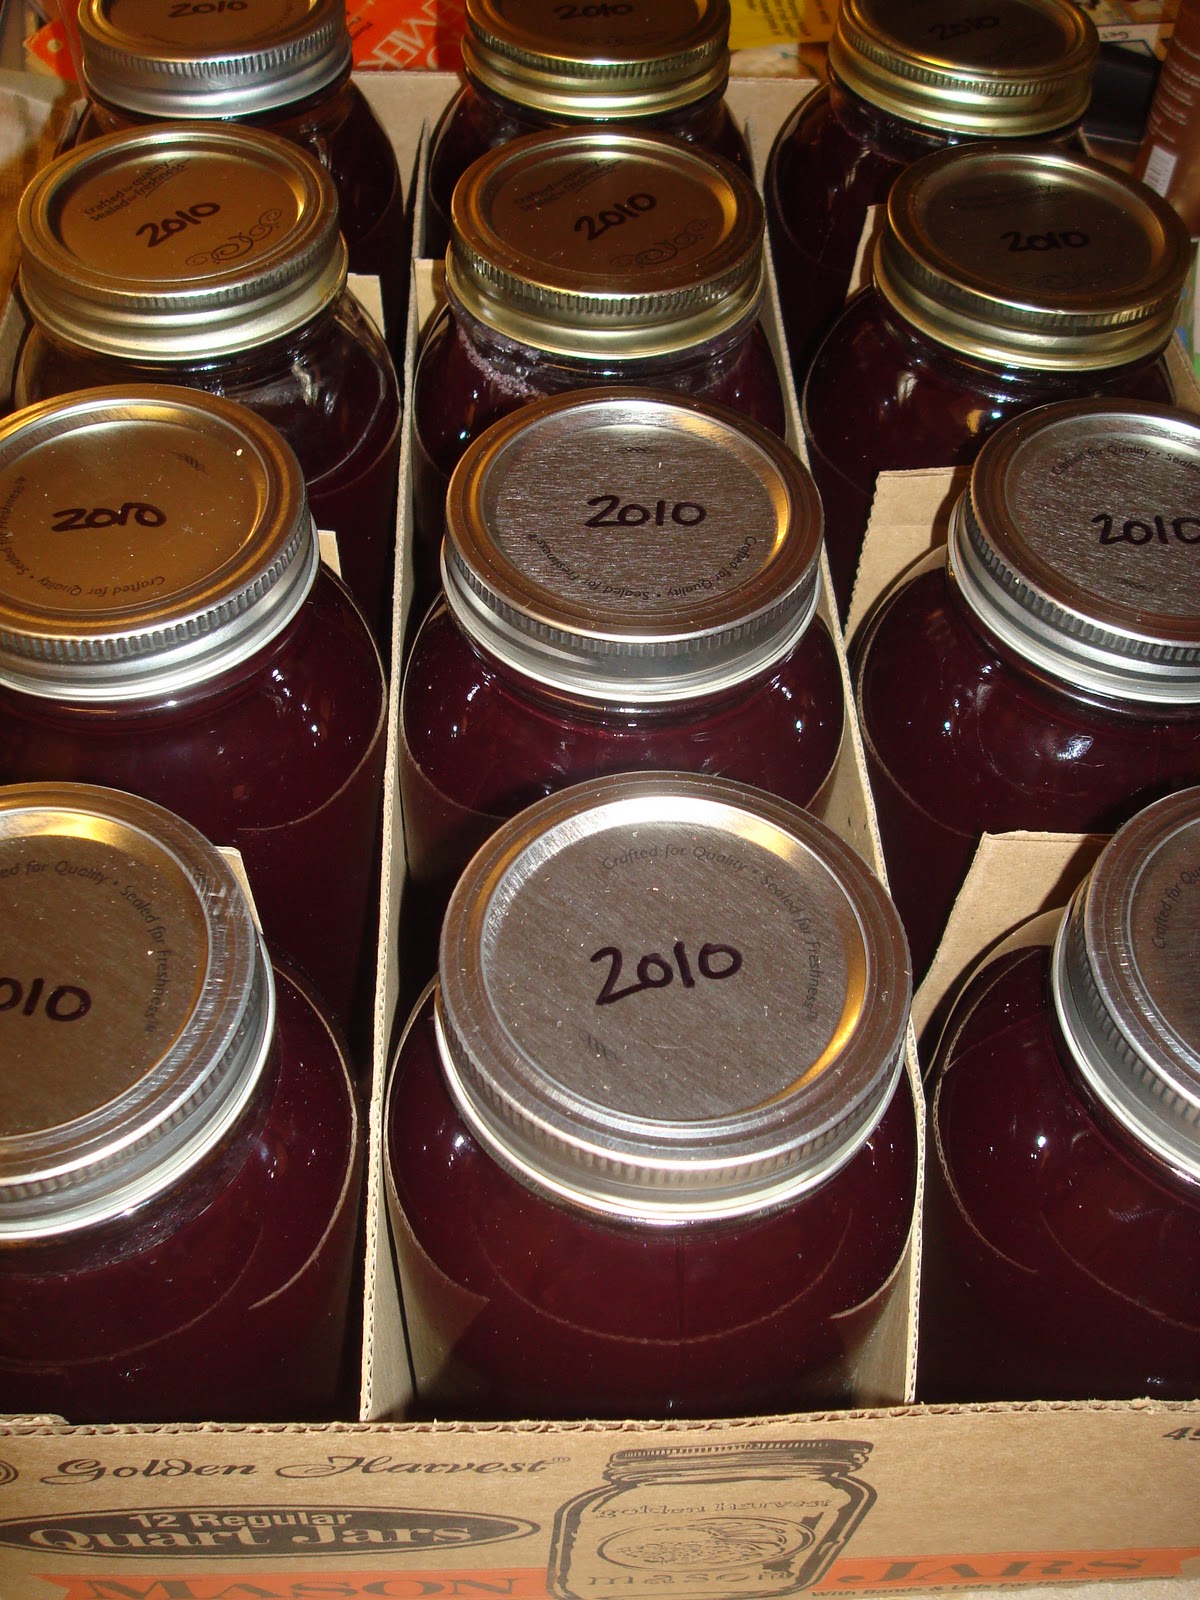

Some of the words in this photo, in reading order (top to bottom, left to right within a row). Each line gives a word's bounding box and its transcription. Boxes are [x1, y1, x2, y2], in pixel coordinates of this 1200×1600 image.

[167, 0, 249, 18] 2010
[554, 3, 634, 20] 2010
[133, 161, 169, 186] quality
[135, 202, 221, 248] 2010
[574, 192, 657, 241] 2010
[1000, 231, 1091, 252] 2010
[1087, 446, 1104, 459] for
[1107, 444, 1151, 459] Quality
[1166, 452, 1200, 475] Seale
[51, 502, 167, 532] 2010
[584, 494, 707, 528] 2010
[1091, 513, 1200, 545] 2010
[729, 535, 757, 570] Crafted
[37, 576, 82, 596] Quality
[112, 576, 166, 596] Crafted
[581, 578, 601, 591] for
[713, 566, 732, 582] for
[87, 586, 108, 597] for
[602, 583, 651, 601] Sealed
[667, 579, 713, 598] Quality
[602, 844, 658, 871] Crafted
[663, 843, 687, 857] for
[693, 845, 748, 873] Quality
[760, 872, 800, 915] Sealed
[793, 917, 811, 935] for
[25, 860, 48, 875] for
[54, 860, 109, 886] Quality
[119, 885, 161, 923] Sealed
[147, 925, 167, 944] for
[1151, 899, 1173, 949] Crafted
[1164, 882, 1183, 904] for
[590, 940, 743, 1006] 2010
[39, 1458, 258, 1485] Golden
[129, 1513, 181, 1528] 12
[189, 1511, 352, 1529] Regular
[595, 1503, 707, 1519] golden
[713, 1498, 833, 1511] harvest
[29, 1526, 270, 1551] Quart
[291, 1523, 472, 1544] Jars
[84, 1577, 527, 1600] MASON
[836, 1557, 1147, 1582] JARS
[587, 1571, 793, 1586] mason
[811, 1589, 856, 1597] With
[862, 1586, 918, 1595] Bands
